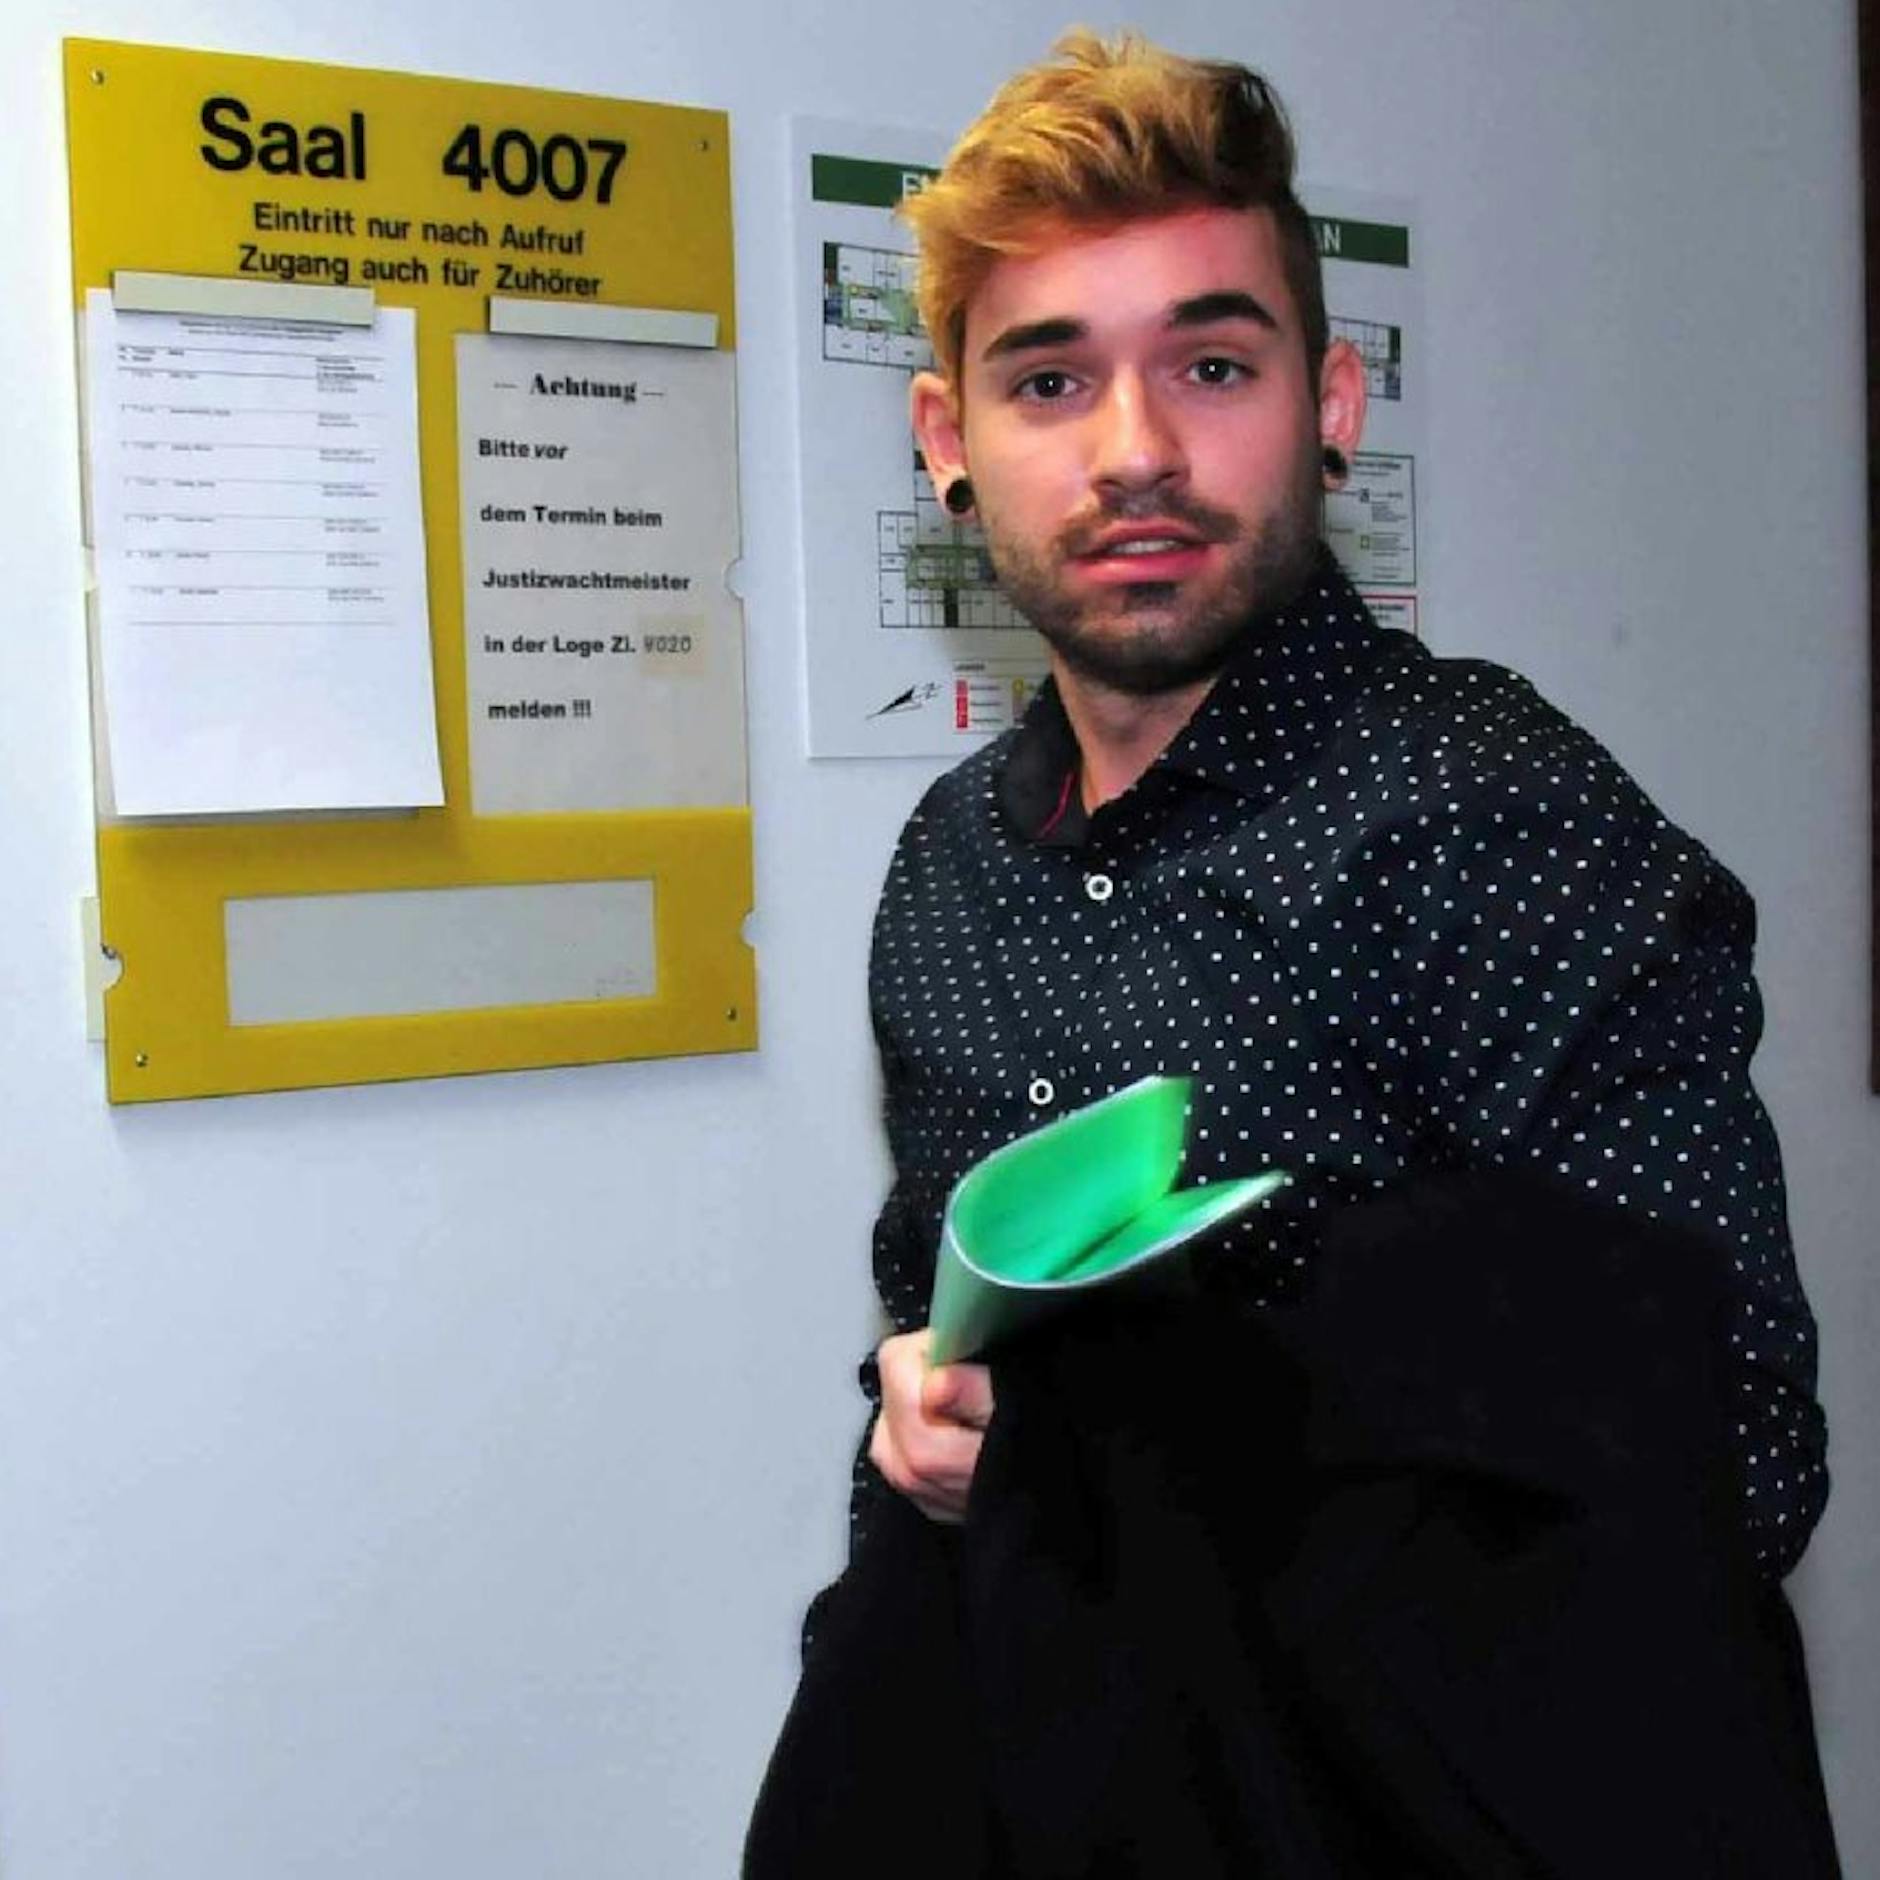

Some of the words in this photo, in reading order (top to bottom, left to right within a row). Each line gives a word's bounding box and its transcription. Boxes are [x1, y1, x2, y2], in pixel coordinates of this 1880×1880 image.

[201, 96, 367, 181] Saal
[442, 123, 629, 206] 4007
[253, 202, 355, 237] Eintritt
[367, 217, 411, 241] nur
[422, 219, 488, 247] nach
[500, 224, 584, 255] Aufruf
[240, 244, 350, 286] Zugang
[361, 256, 428, 285] auch
[442, 257, 480, 287] für
[496, 262, 600, 298] Zuhörer
[530, 373, 638, 402] Achtung
[479, 438, 529, 459] Bitte
[534, 445, 568, 460] vor
[480, 504, 526, 522] dem
[533, 505, 606, 524] Termin
[613, 507, 663, 527] beim
[483, 569, 691, 591] Justizwachtmeister
[485, 636, 505, 653] in
[511, 636, 547, 653] der
[553, 636, 605, 658] Loge
[488, 700, 566, 719] melden
